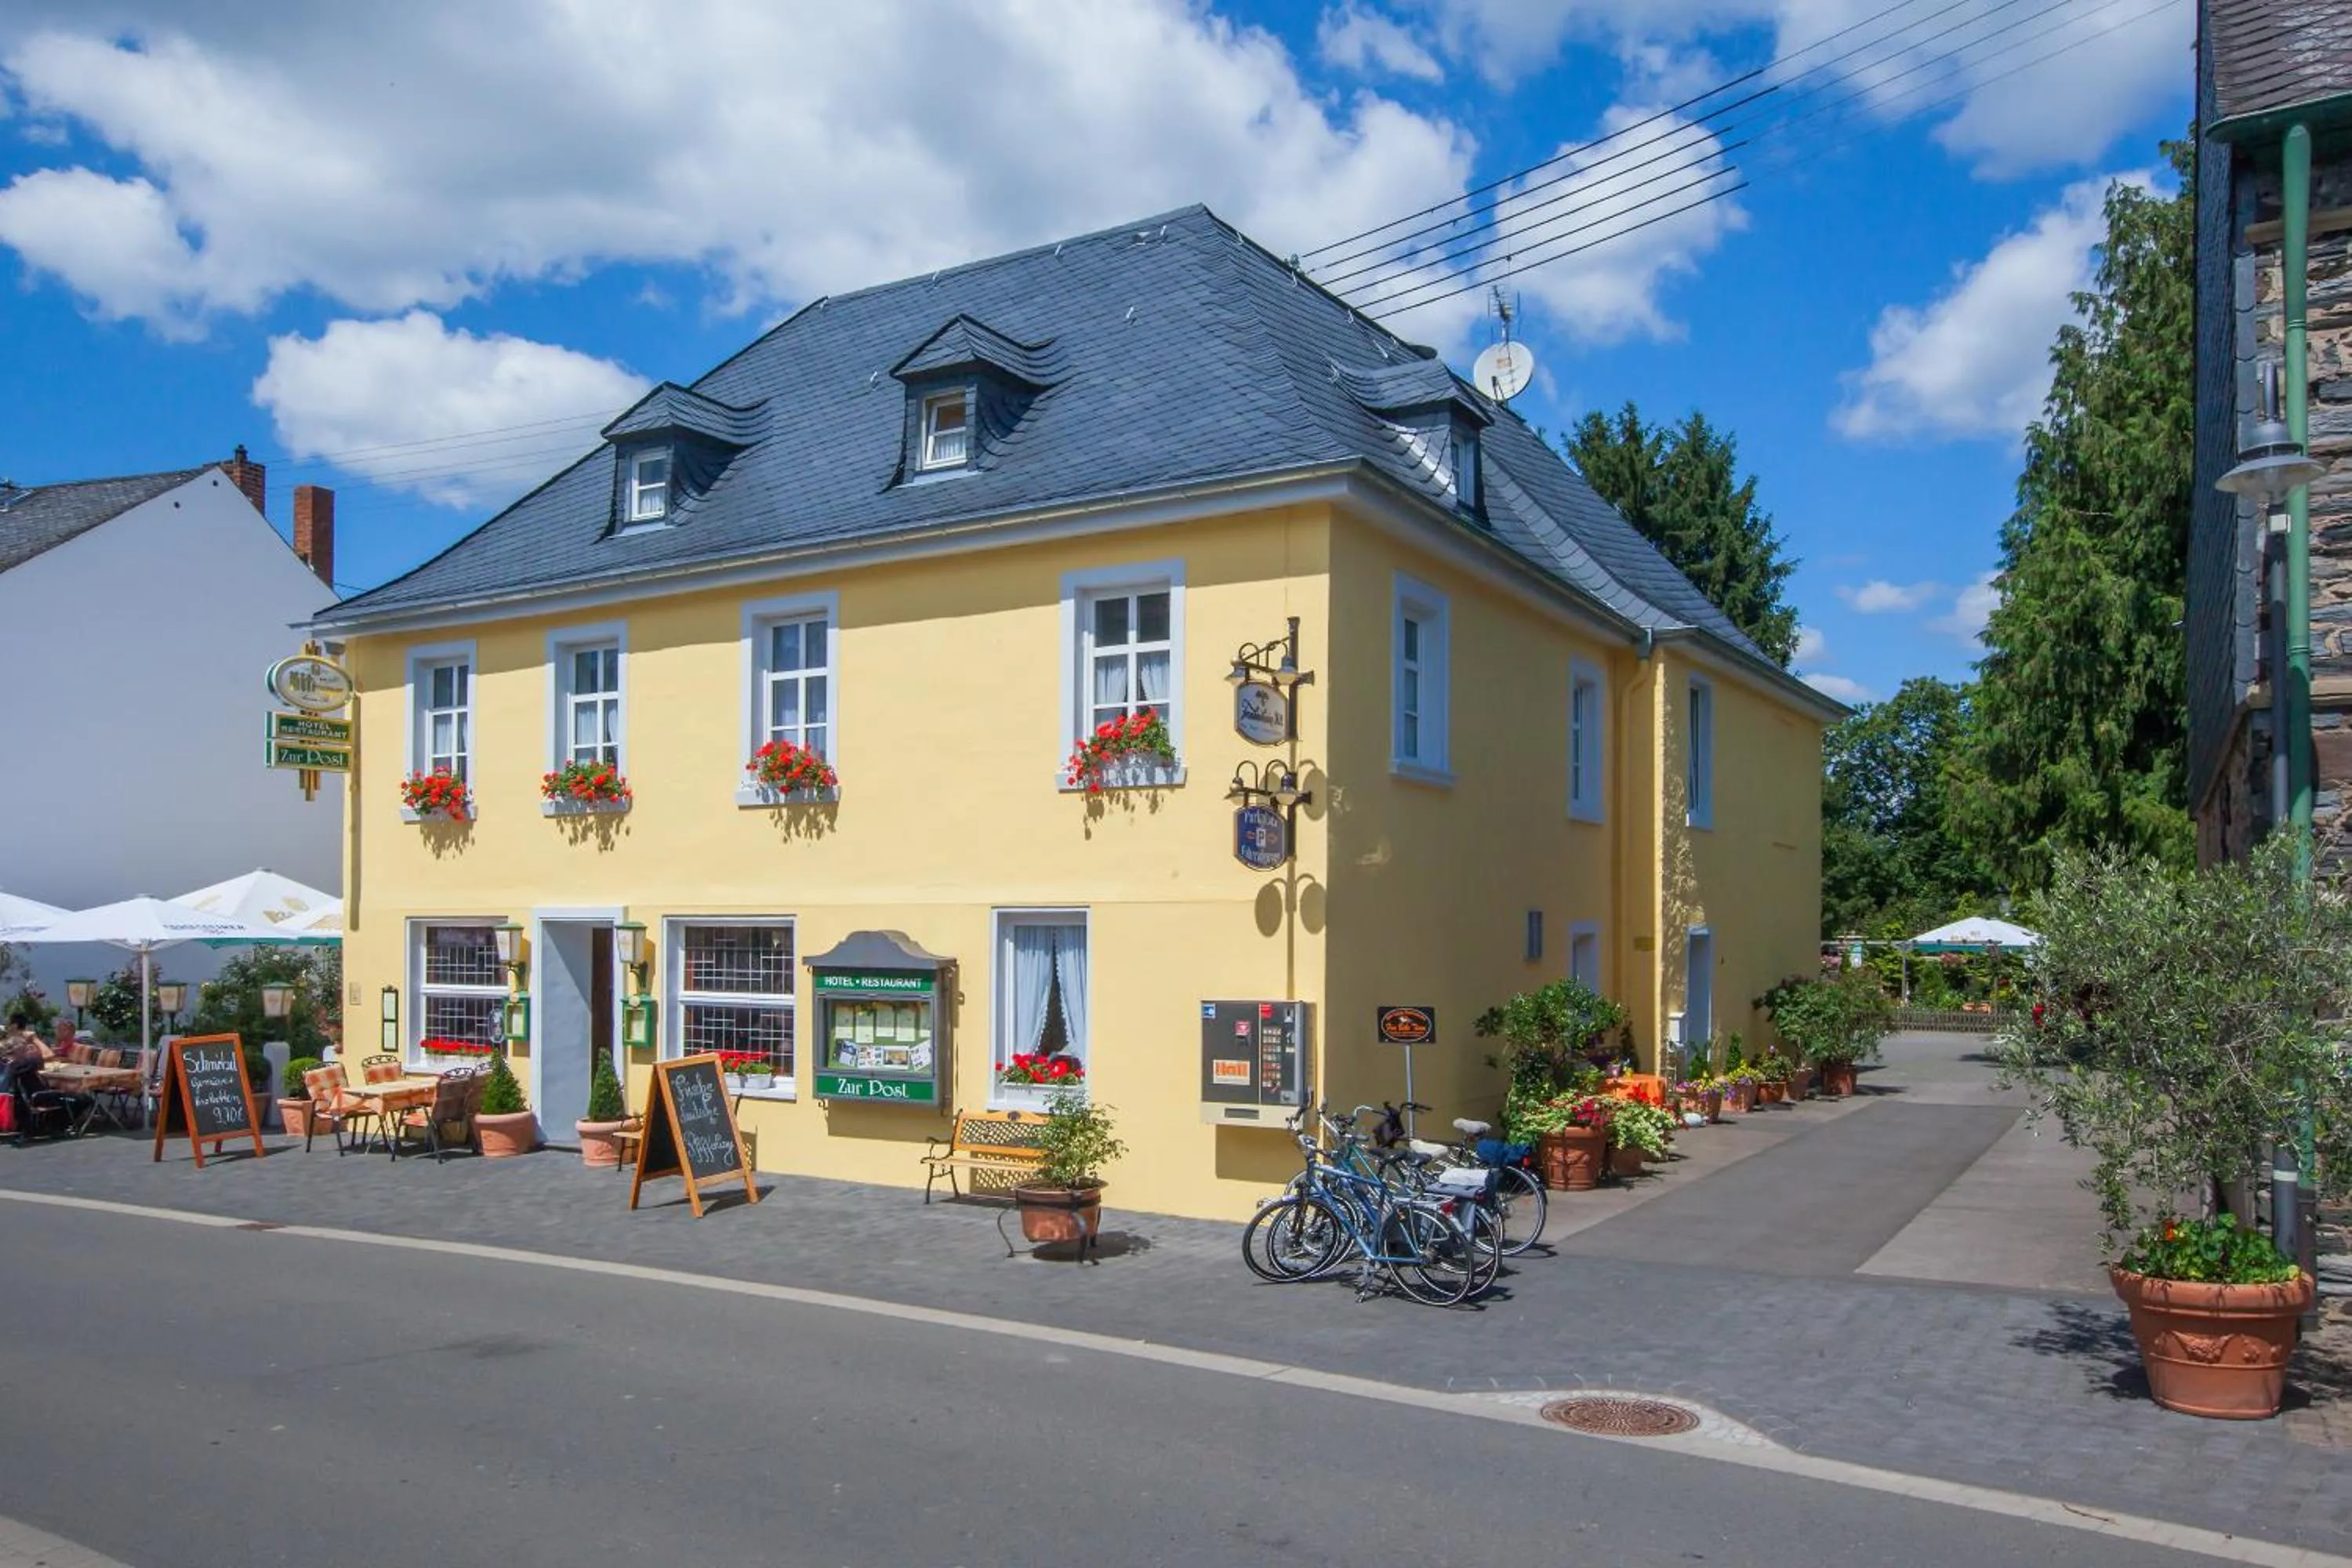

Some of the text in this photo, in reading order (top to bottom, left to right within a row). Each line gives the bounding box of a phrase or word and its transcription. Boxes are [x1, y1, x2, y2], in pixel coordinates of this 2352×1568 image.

[281, 725, 347, 739] RESTAURANT
[299, 720, 331, 731] HOTEL
[281, 749, 344, 767] Zur Post
[826, 977, 923, 989] HOTEL RESTAURANT
[837, 1078, 910, 1098] Zur Post
